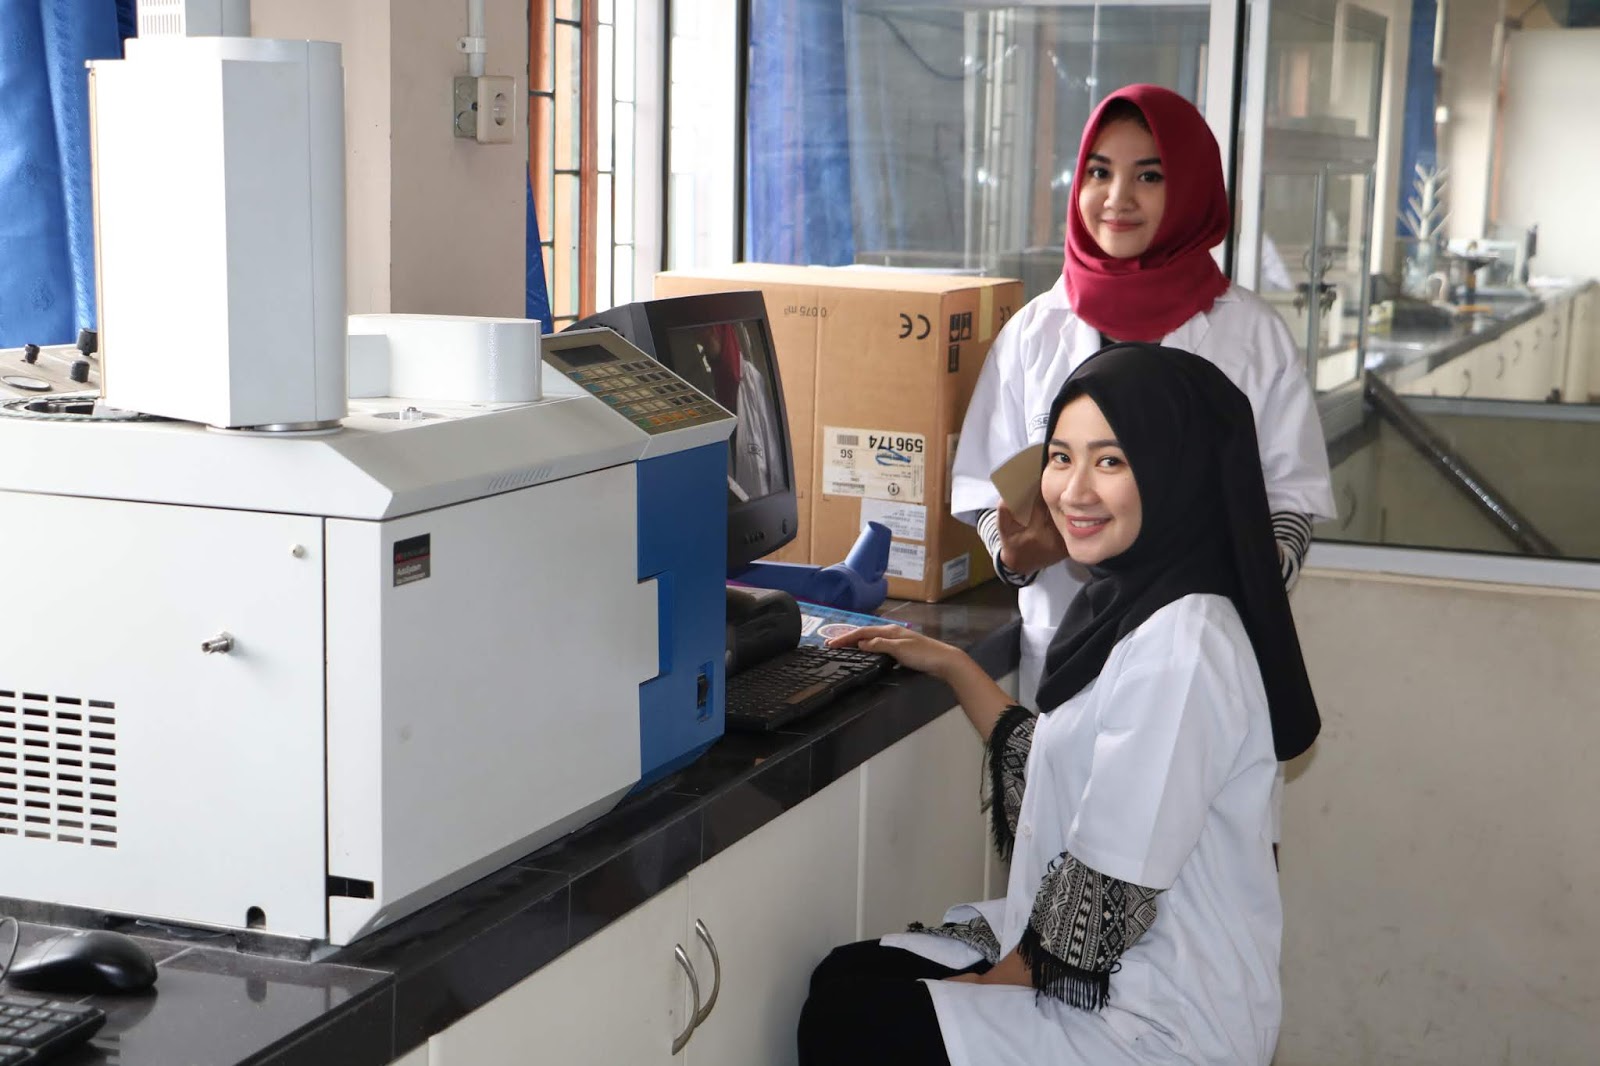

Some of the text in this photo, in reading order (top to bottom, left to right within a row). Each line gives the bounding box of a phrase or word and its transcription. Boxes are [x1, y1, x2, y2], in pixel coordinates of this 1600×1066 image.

[899, 313, 931, 340] CE
[868, 434, 923, 453] 596174
[840, 448, 853, 459] SG
